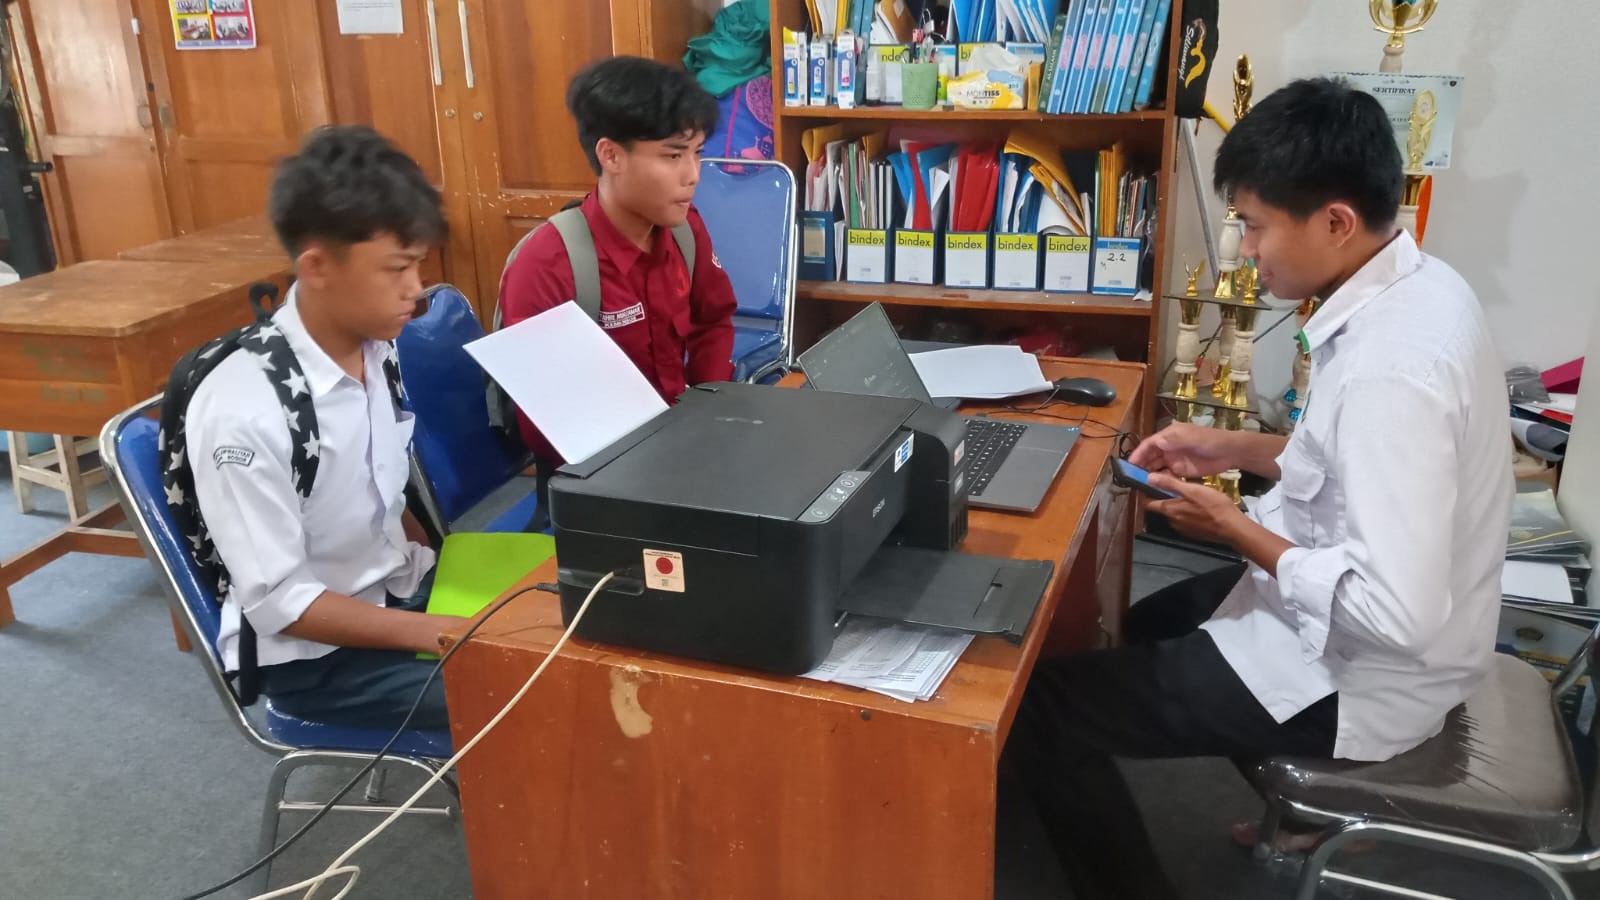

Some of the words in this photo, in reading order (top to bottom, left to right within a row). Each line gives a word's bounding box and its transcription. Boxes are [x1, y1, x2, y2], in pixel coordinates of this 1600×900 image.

[1372, 87, 1417, 95] SERTIFIKAT
[849, 231, 885, 245] bindex
[898, 232, 931, 247] bindex
[948, 236, 982, 249] bindex
[998, 236, 1033, 250] bindex
[1048, 237, 1088, 251] bindex
[1107, 252, 1126, 262] 2.2
